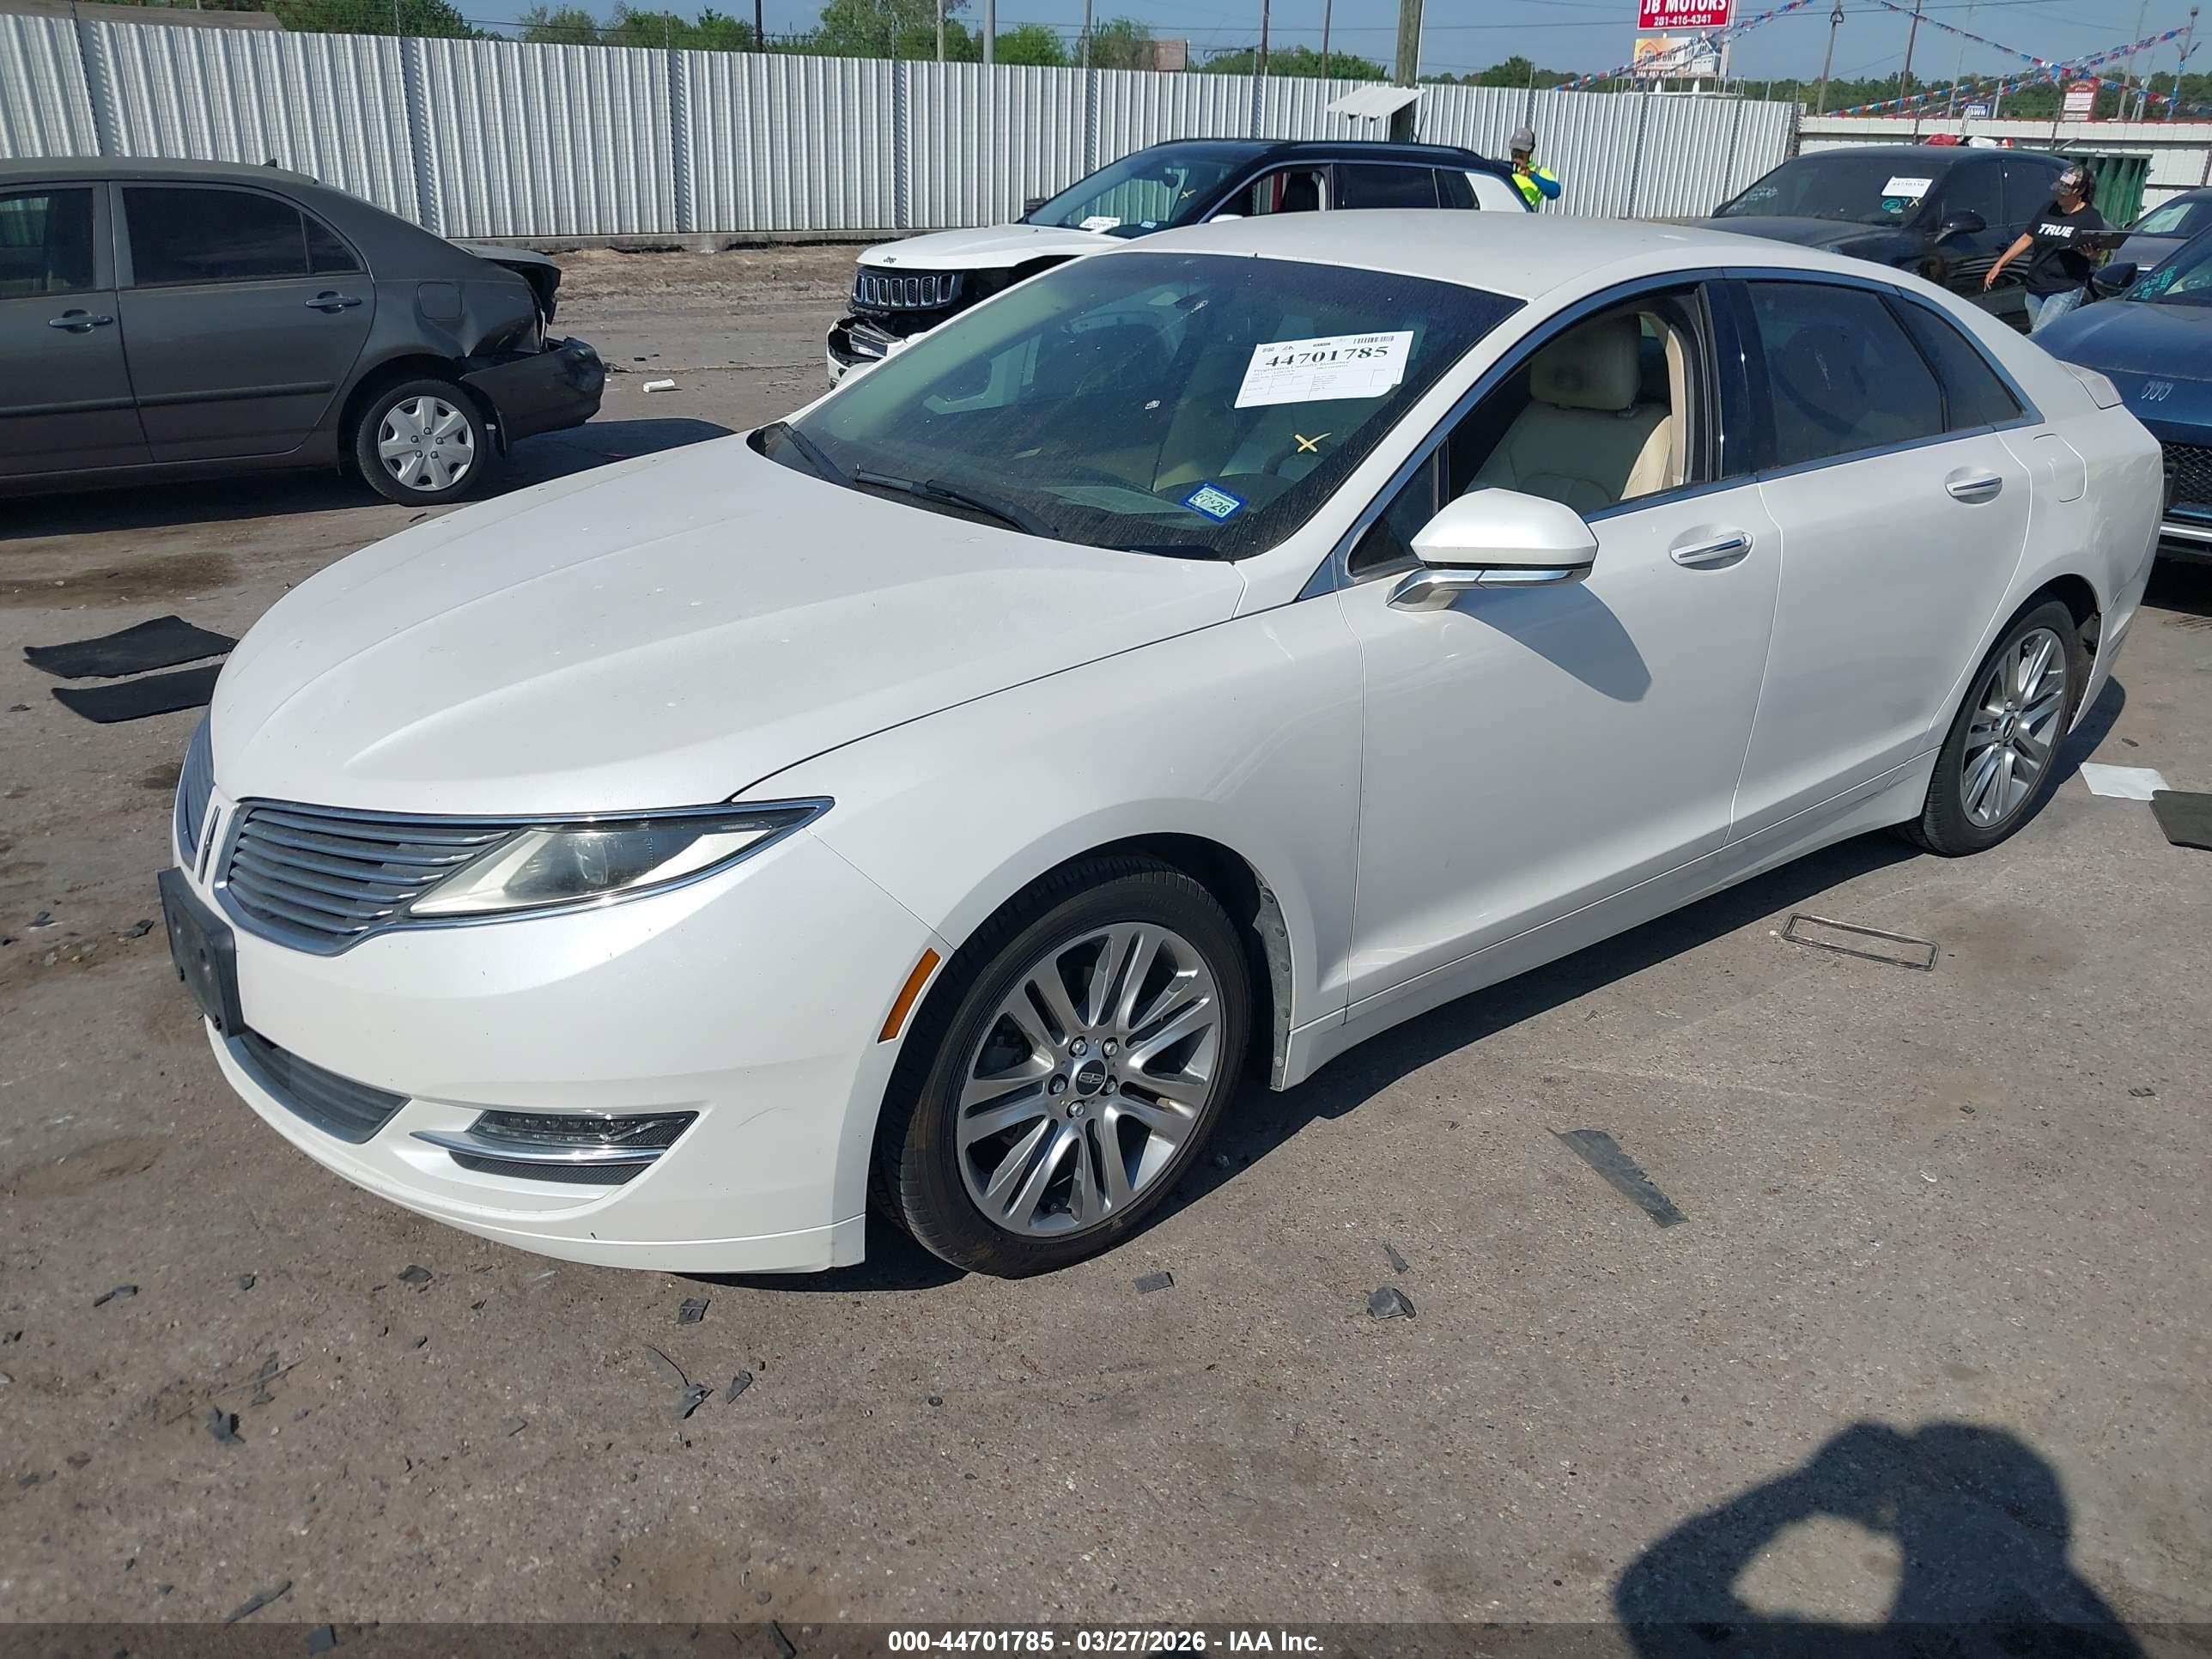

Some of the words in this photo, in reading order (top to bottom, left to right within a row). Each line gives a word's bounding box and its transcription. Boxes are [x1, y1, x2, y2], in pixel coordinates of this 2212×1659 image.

[1644, 0, 1661, 15] JB
[2038, 222, 2075, 239] TRUE
[1266, 346, 1389, 367] 44701785
